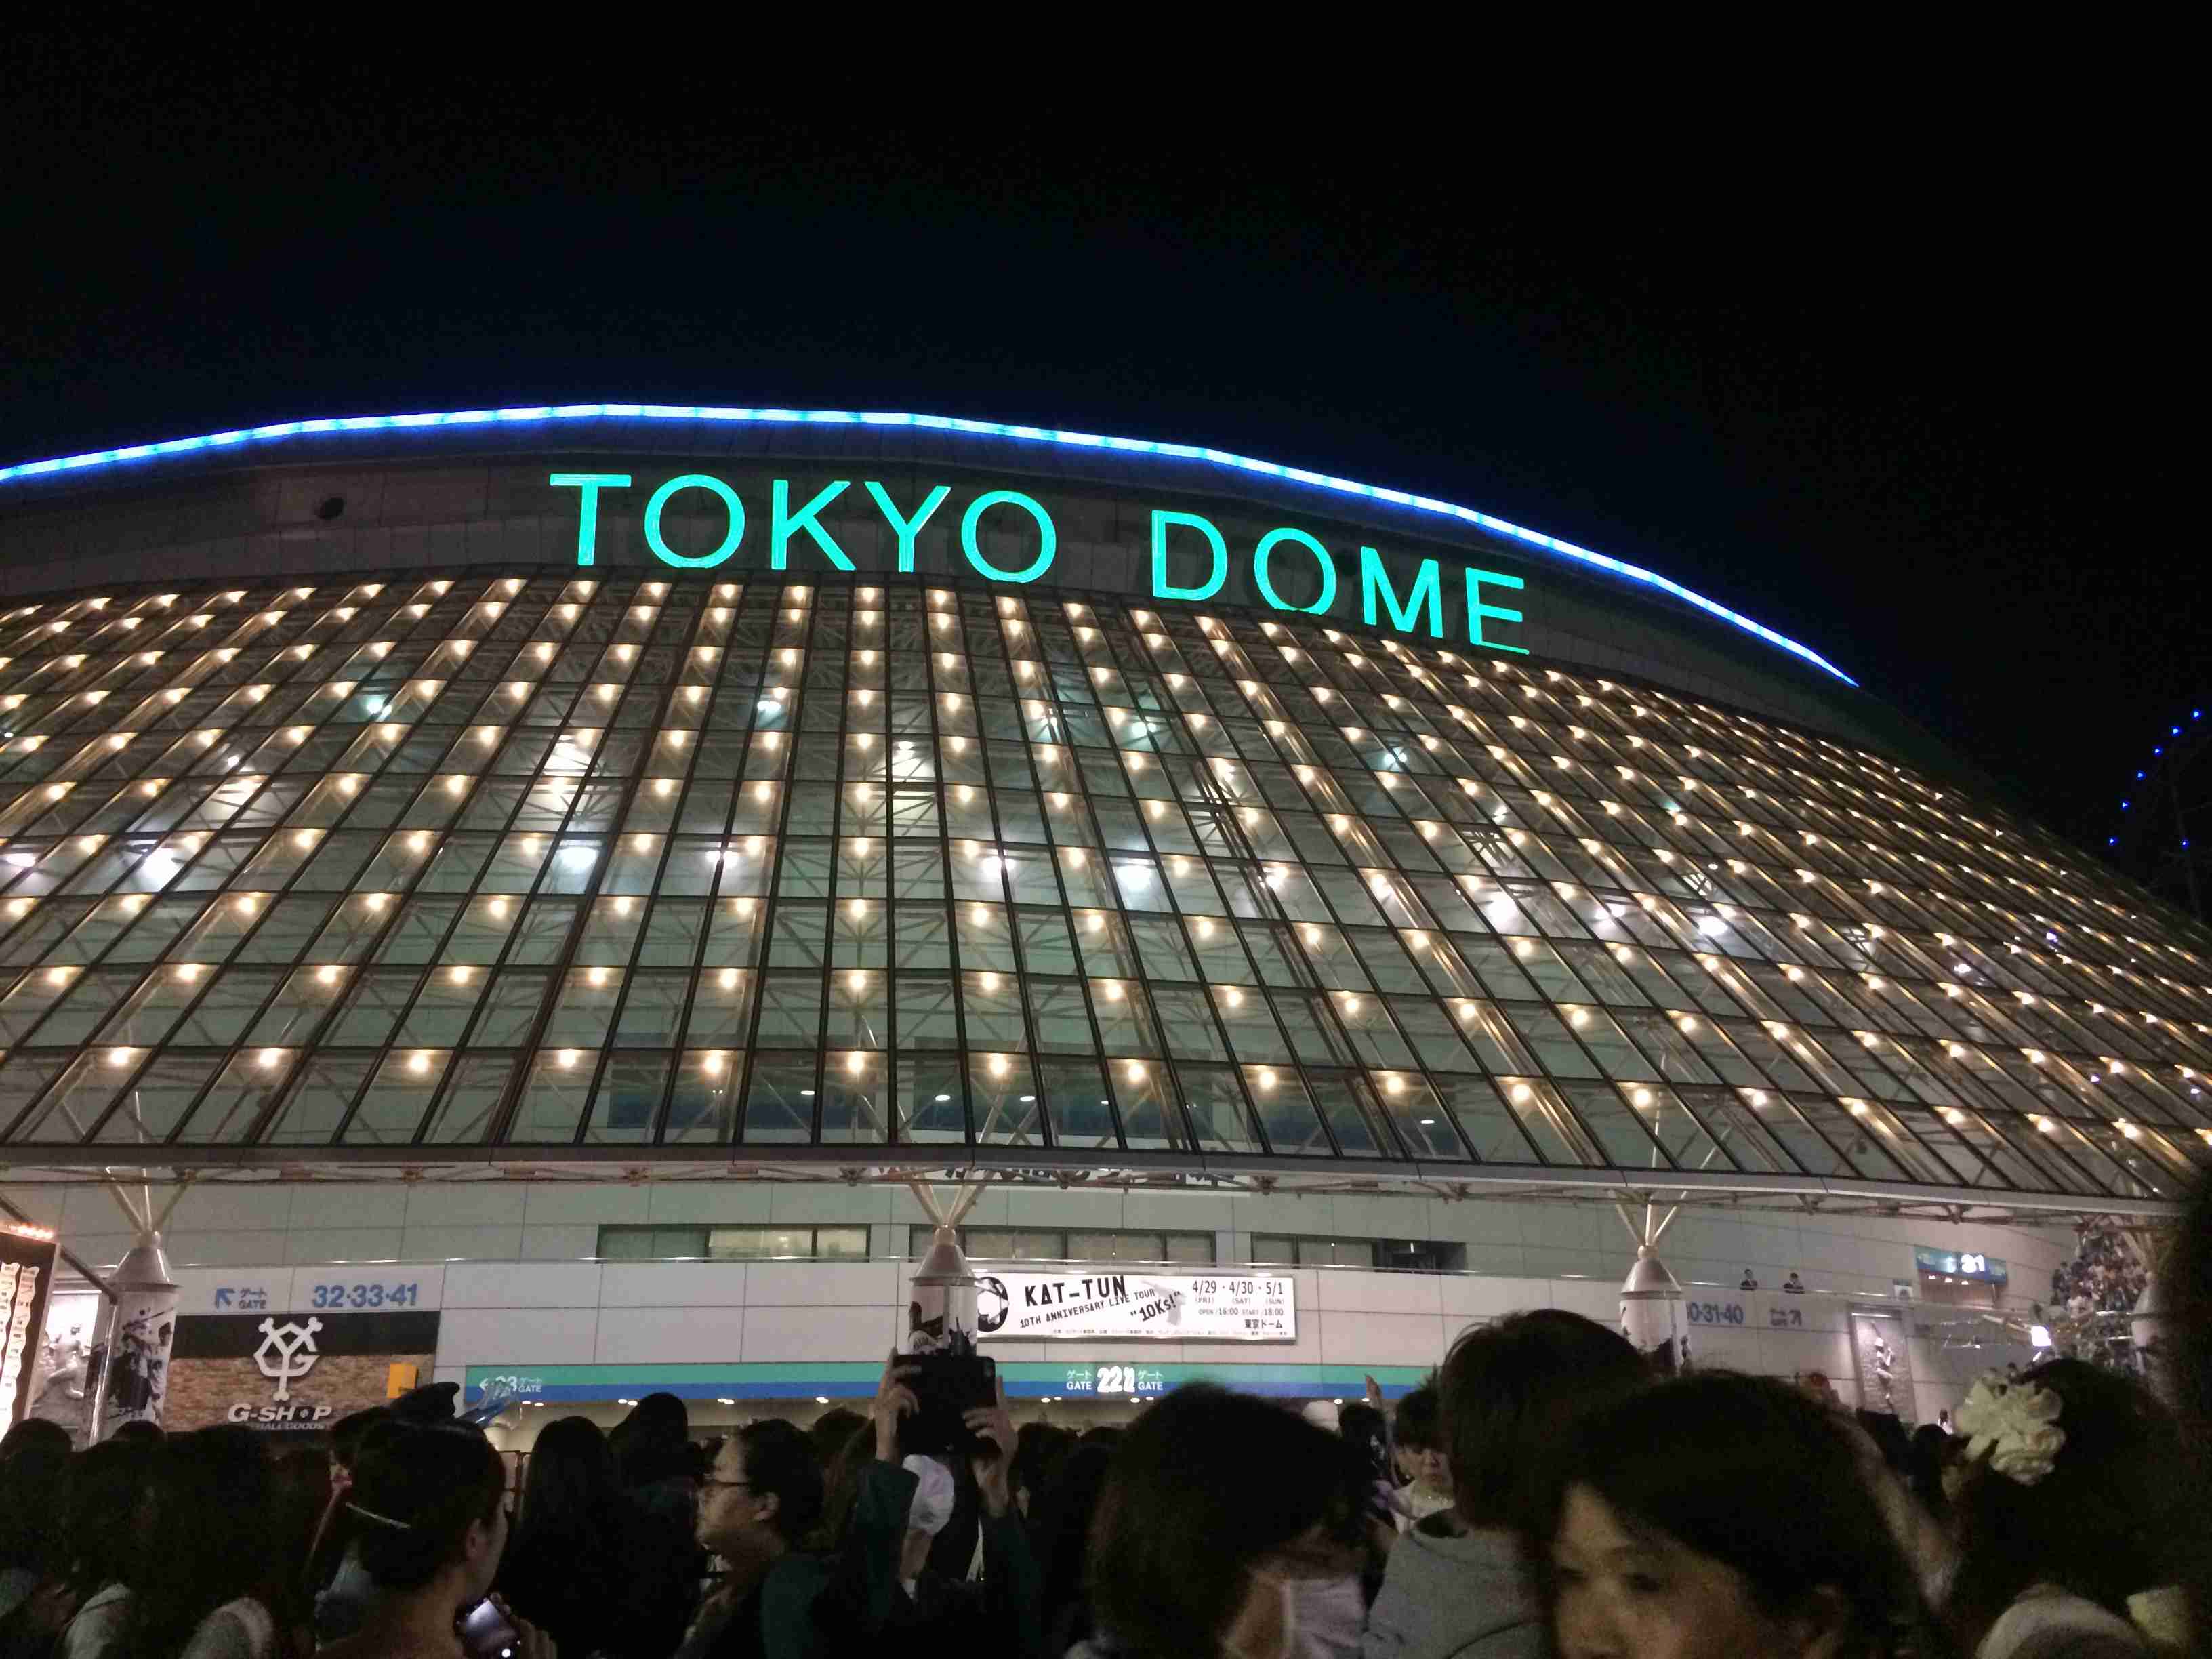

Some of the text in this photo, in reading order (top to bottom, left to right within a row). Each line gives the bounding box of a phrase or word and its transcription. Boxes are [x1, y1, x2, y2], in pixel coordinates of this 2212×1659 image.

[548, 472, 1530, 655] TOKYO DOME
[1025, 1275, 1126, 1307] KAT-TUN
[1192, 1279, 1283, 1297] 4/29 4/30 5/1
[238, 1300, 266, 1309] GATE
[1020, 1288, 1155, 1328] 10TH ANNIVERSARY LIVE TOUR
[518, 1385, 542, 1393] GATE
[1066, 1381, 1092, 1390] GATE
[1138, 1381, 1164, 1390] GATE
